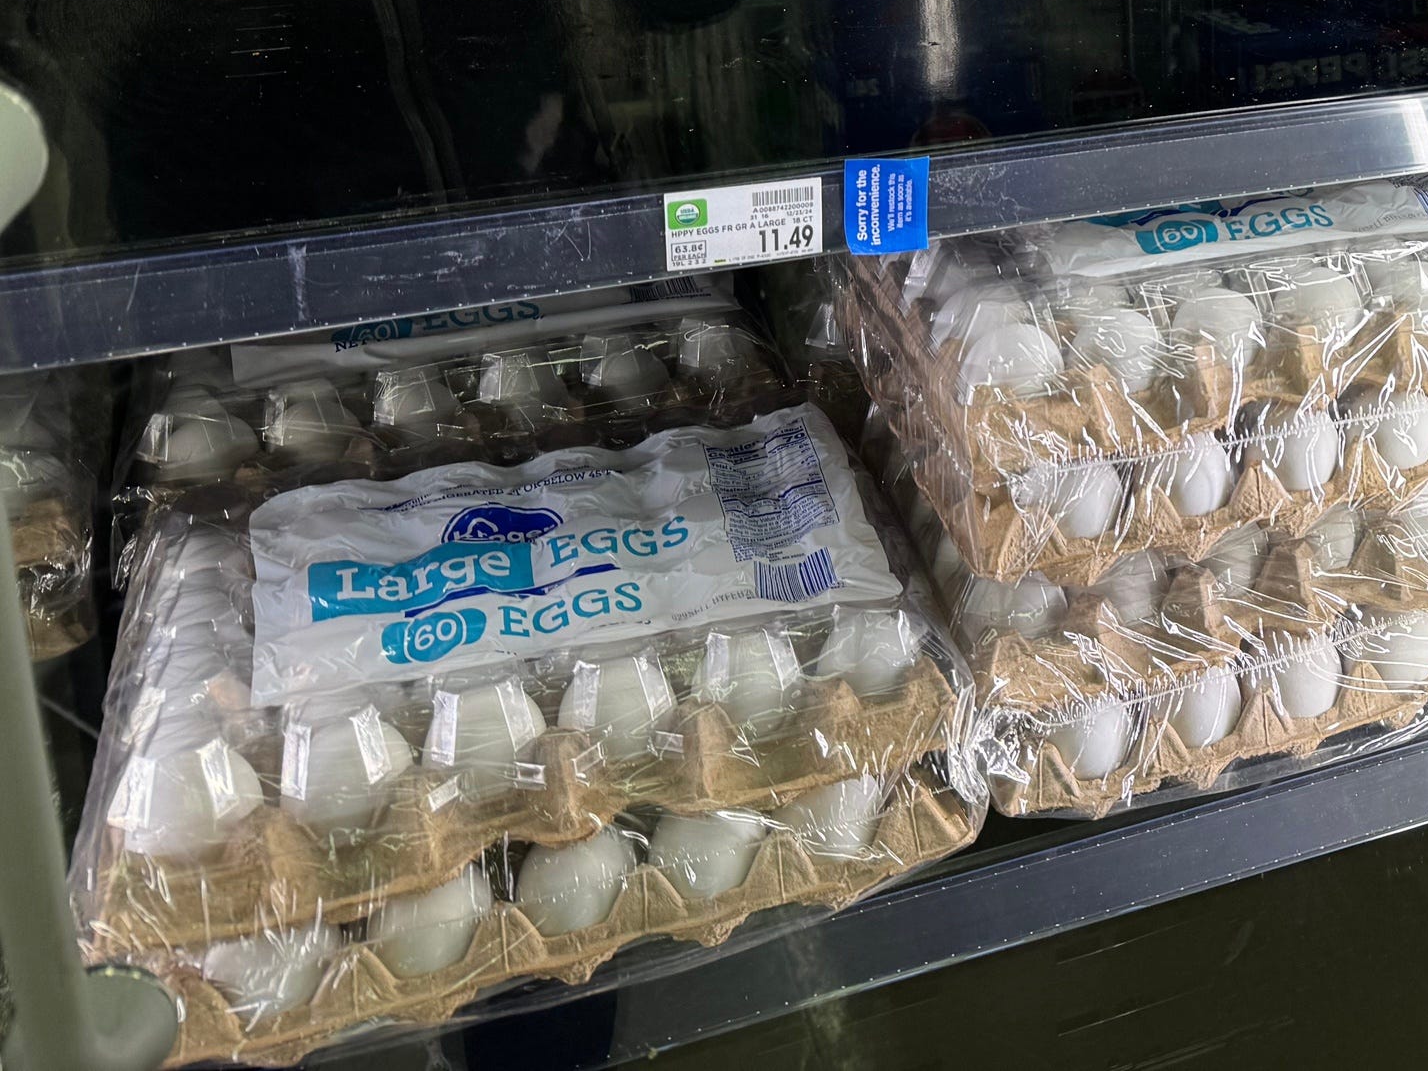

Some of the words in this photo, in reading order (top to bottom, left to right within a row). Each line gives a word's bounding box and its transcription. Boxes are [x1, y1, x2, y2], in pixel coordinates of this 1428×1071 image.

[856, 169, 867, 189] the
[856, 190, 867, 207] for
[869, 164, 881, 246] inconvenience.
[671, 230, 693, 238] HPPY
[696, 227, 720, 236] EGGS
[722, 224, 733, 232] FR
[758, 218, 786, 228] LARGE
[857, 208, 868, 241] Sorry
[1163, 226, 1199, 245] 60
[1228, 204, 1335, 241] EGGS
[674, 243, 703, 254] 63.8¢
[758, 225, 814, 253] 11.49
[542, 471, 586, 486] BELOW
[333, 550, 514, 603] Large
[549, 515, 691, 568] EGGS
[412, 618, 458, 649] 60
[496, 581, 646, 638] EGGS
